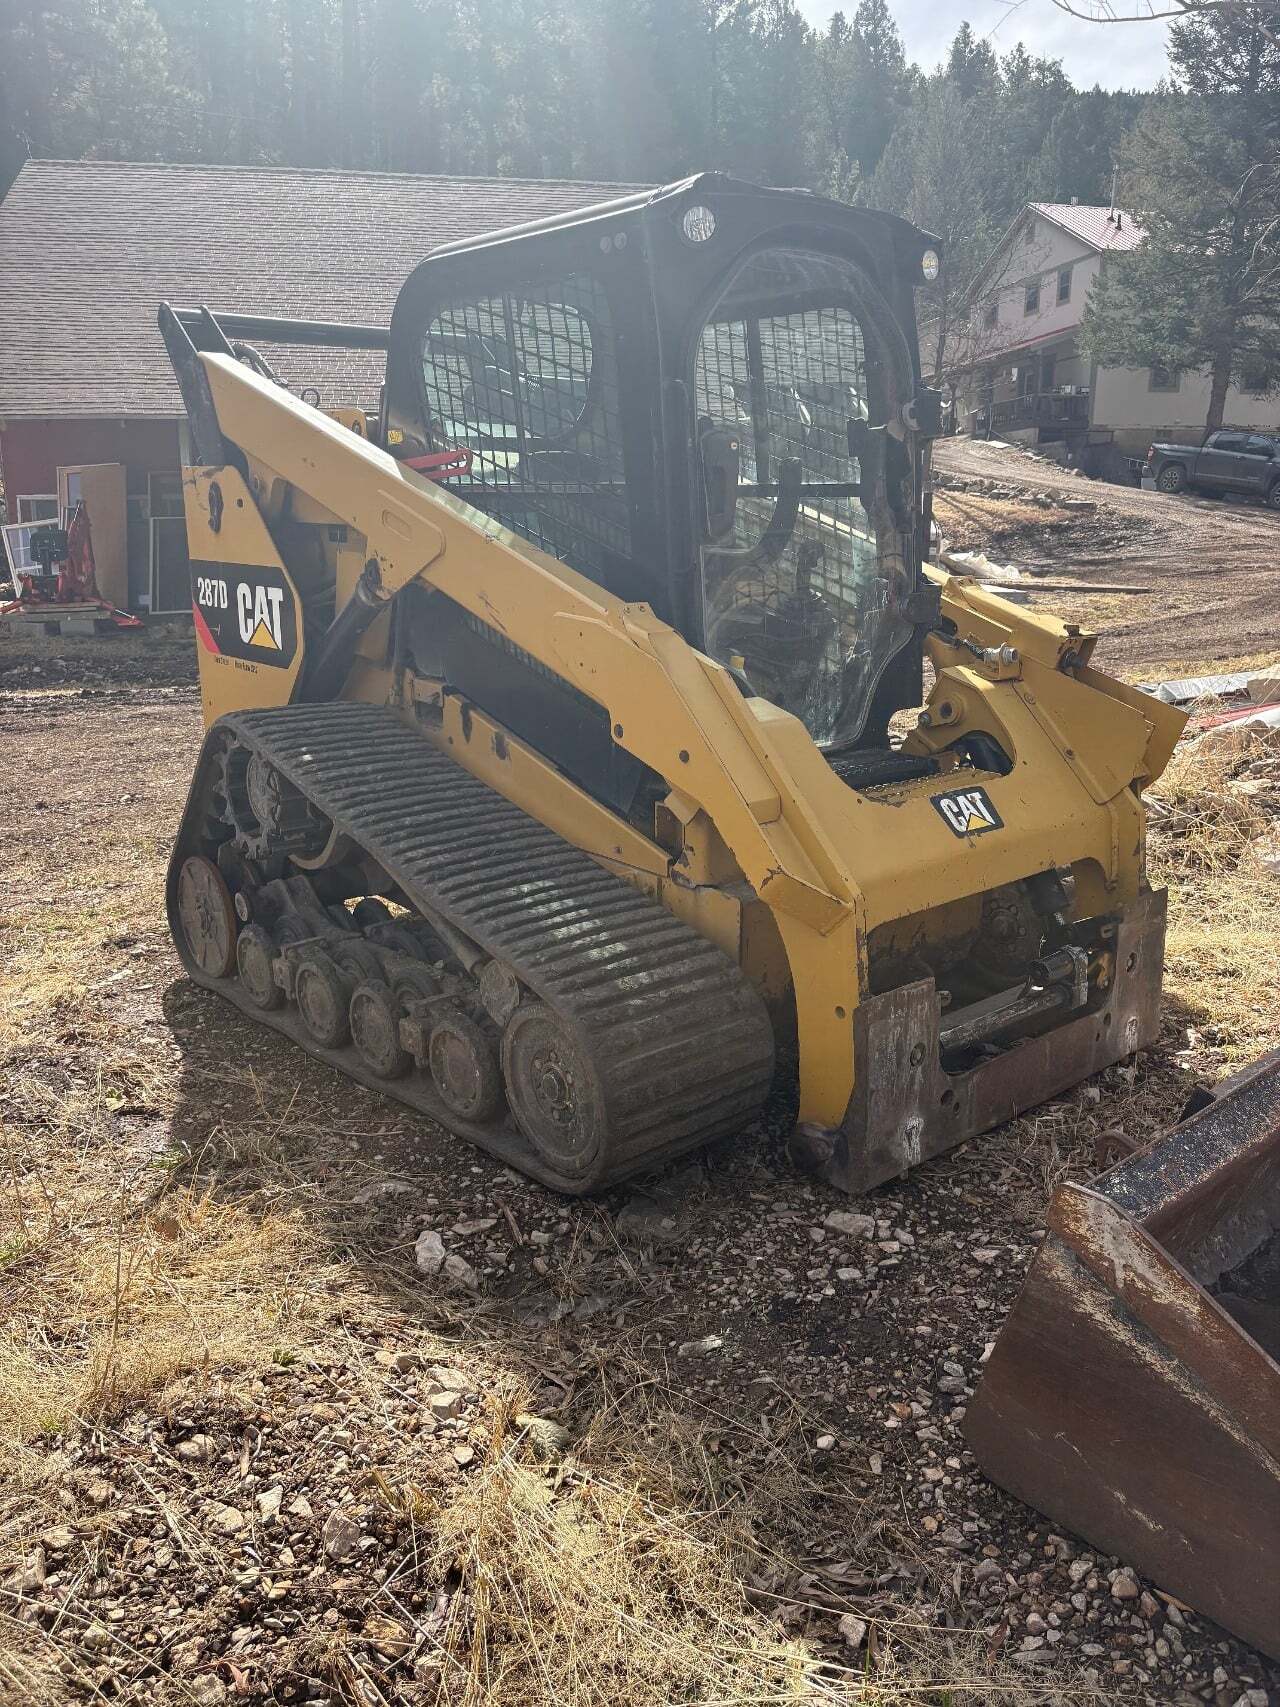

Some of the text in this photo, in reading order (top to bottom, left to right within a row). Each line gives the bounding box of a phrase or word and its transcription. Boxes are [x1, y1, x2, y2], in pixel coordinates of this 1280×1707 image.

[198, 577, 228, 608] 287D
[236, 582, 284, 650] CAT
[940, 792, 996, 832] CAT
